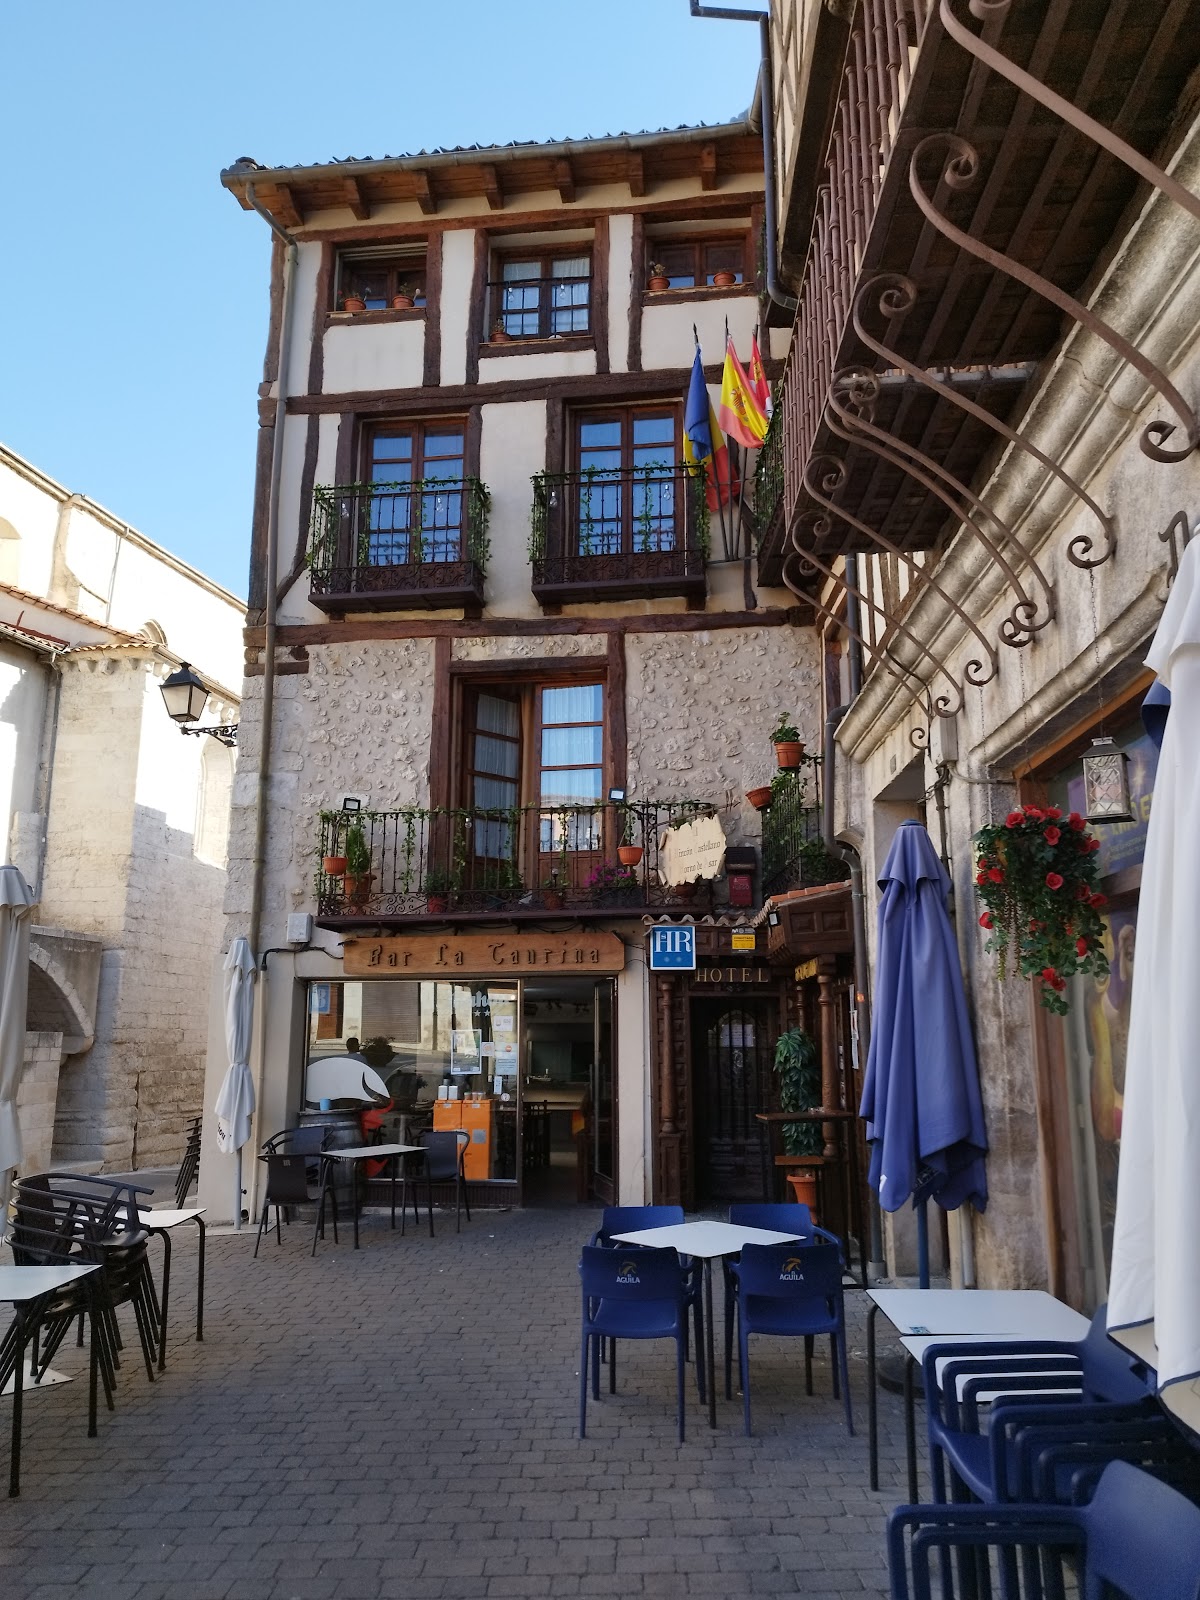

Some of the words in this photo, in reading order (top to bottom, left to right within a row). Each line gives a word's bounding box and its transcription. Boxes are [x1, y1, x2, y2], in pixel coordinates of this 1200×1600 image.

[681, 864, 696, 874] orno
[696, 861, 703, 871] de
[367, 943, 412, 967] Bar
[434, 942, 464, 966] La
[488, 941, 600, 965] Taurina
[696, 967, 769, 983] HOTEL
